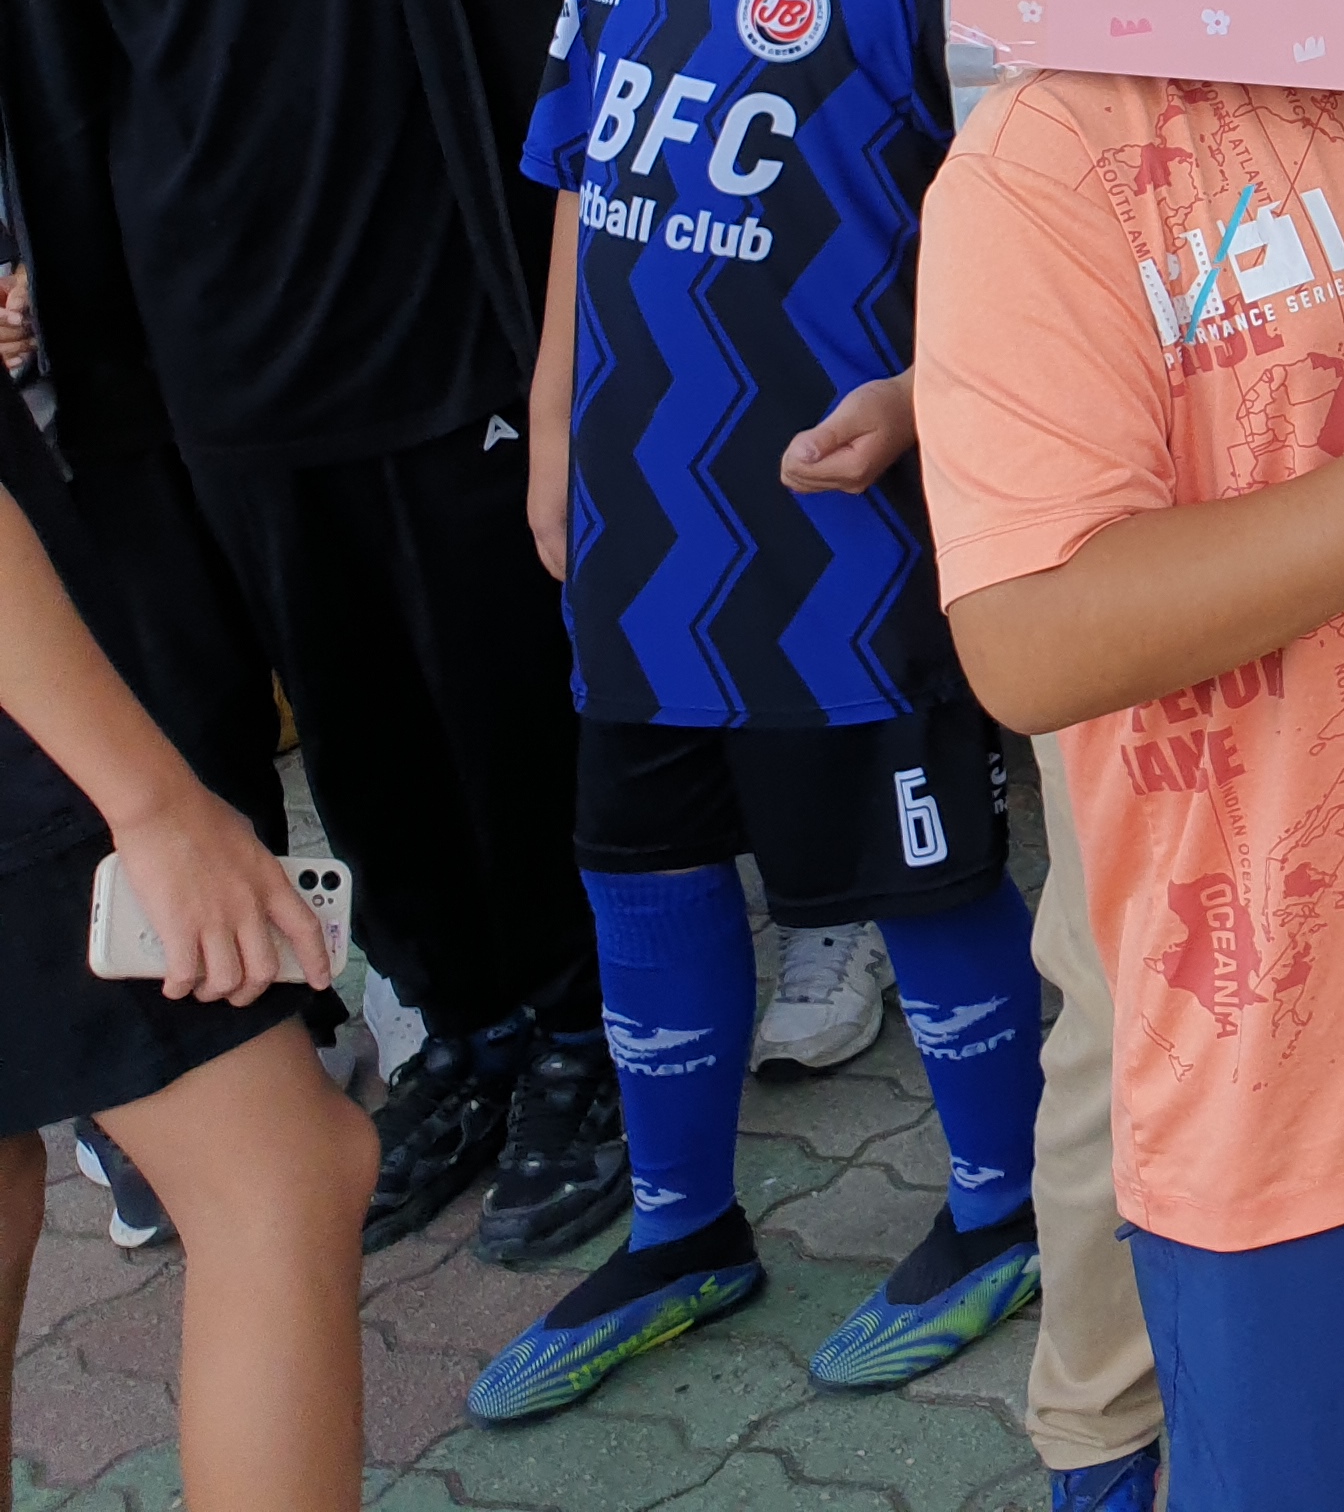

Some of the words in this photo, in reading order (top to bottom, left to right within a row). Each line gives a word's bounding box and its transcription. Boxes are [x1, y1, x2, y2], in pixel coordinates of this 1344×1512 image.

[1097, 158, 1136, 223] SOUTH
[665, 210, 773, 262] club
[895, 767, 948, 868] 6
[1220, 783, 1246, 836] INDIAN
[1200, 883, 1239, 1039] OCEANIA
